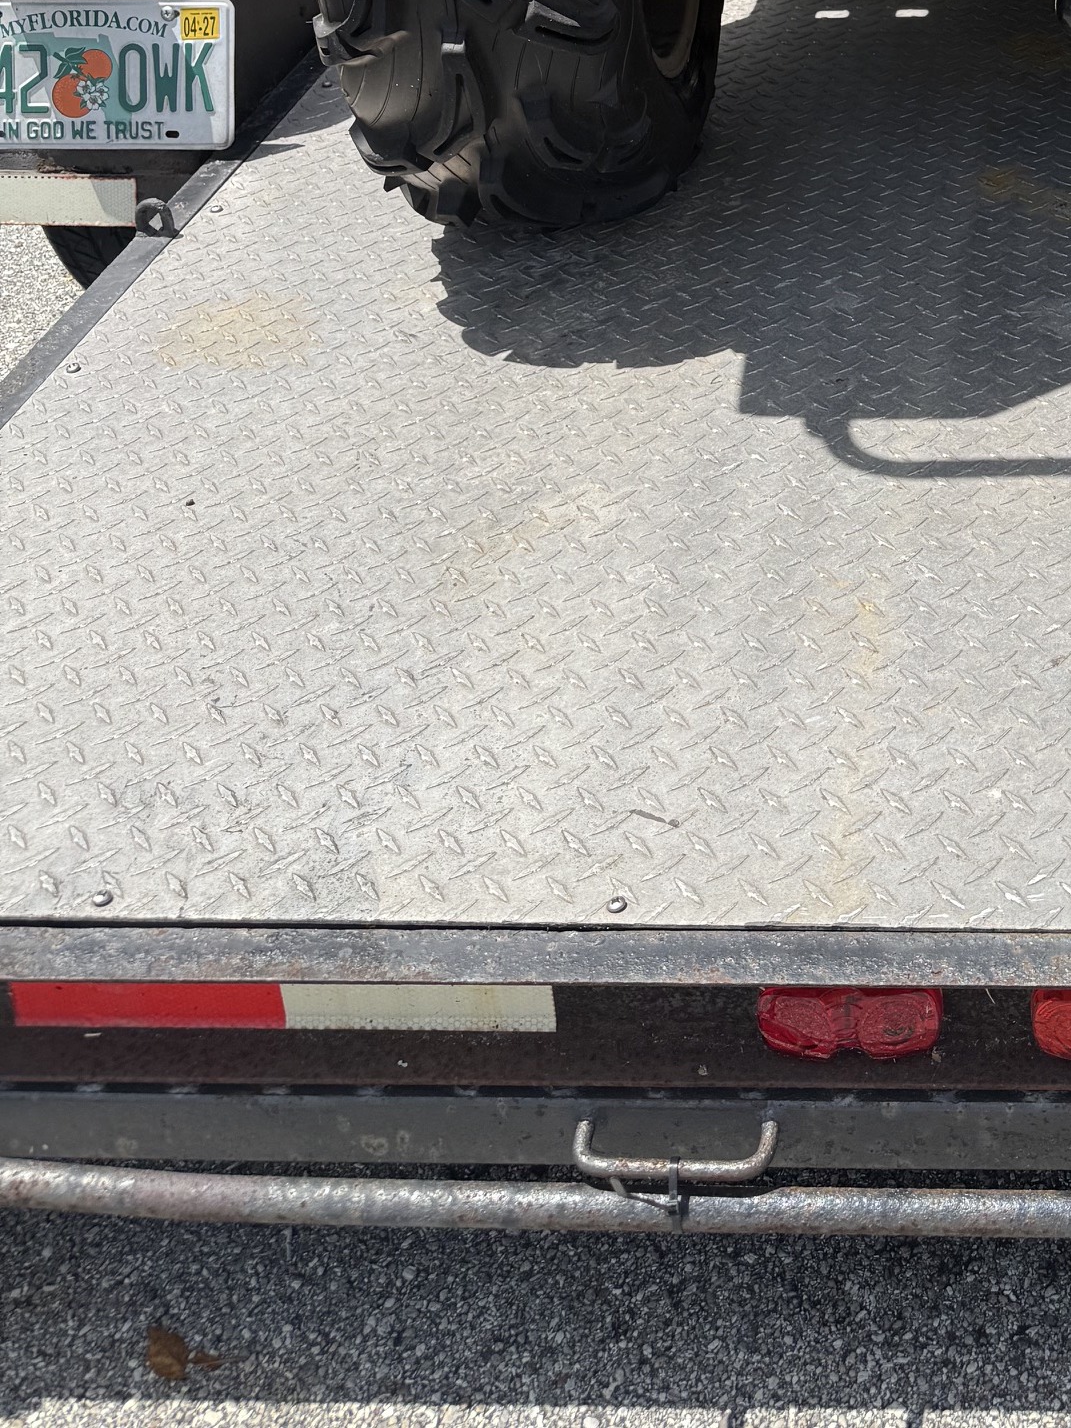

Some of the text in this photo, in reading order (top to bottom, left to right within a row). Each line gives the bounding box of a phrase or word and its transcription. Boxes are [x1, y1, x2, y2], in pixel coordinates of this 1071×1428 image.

[118, 42, 215, 113] OWK
[27, 121, 64, 139] GOD
[72, 121, 97, 139] WE
[104, 121, 164, 140] TRUST
